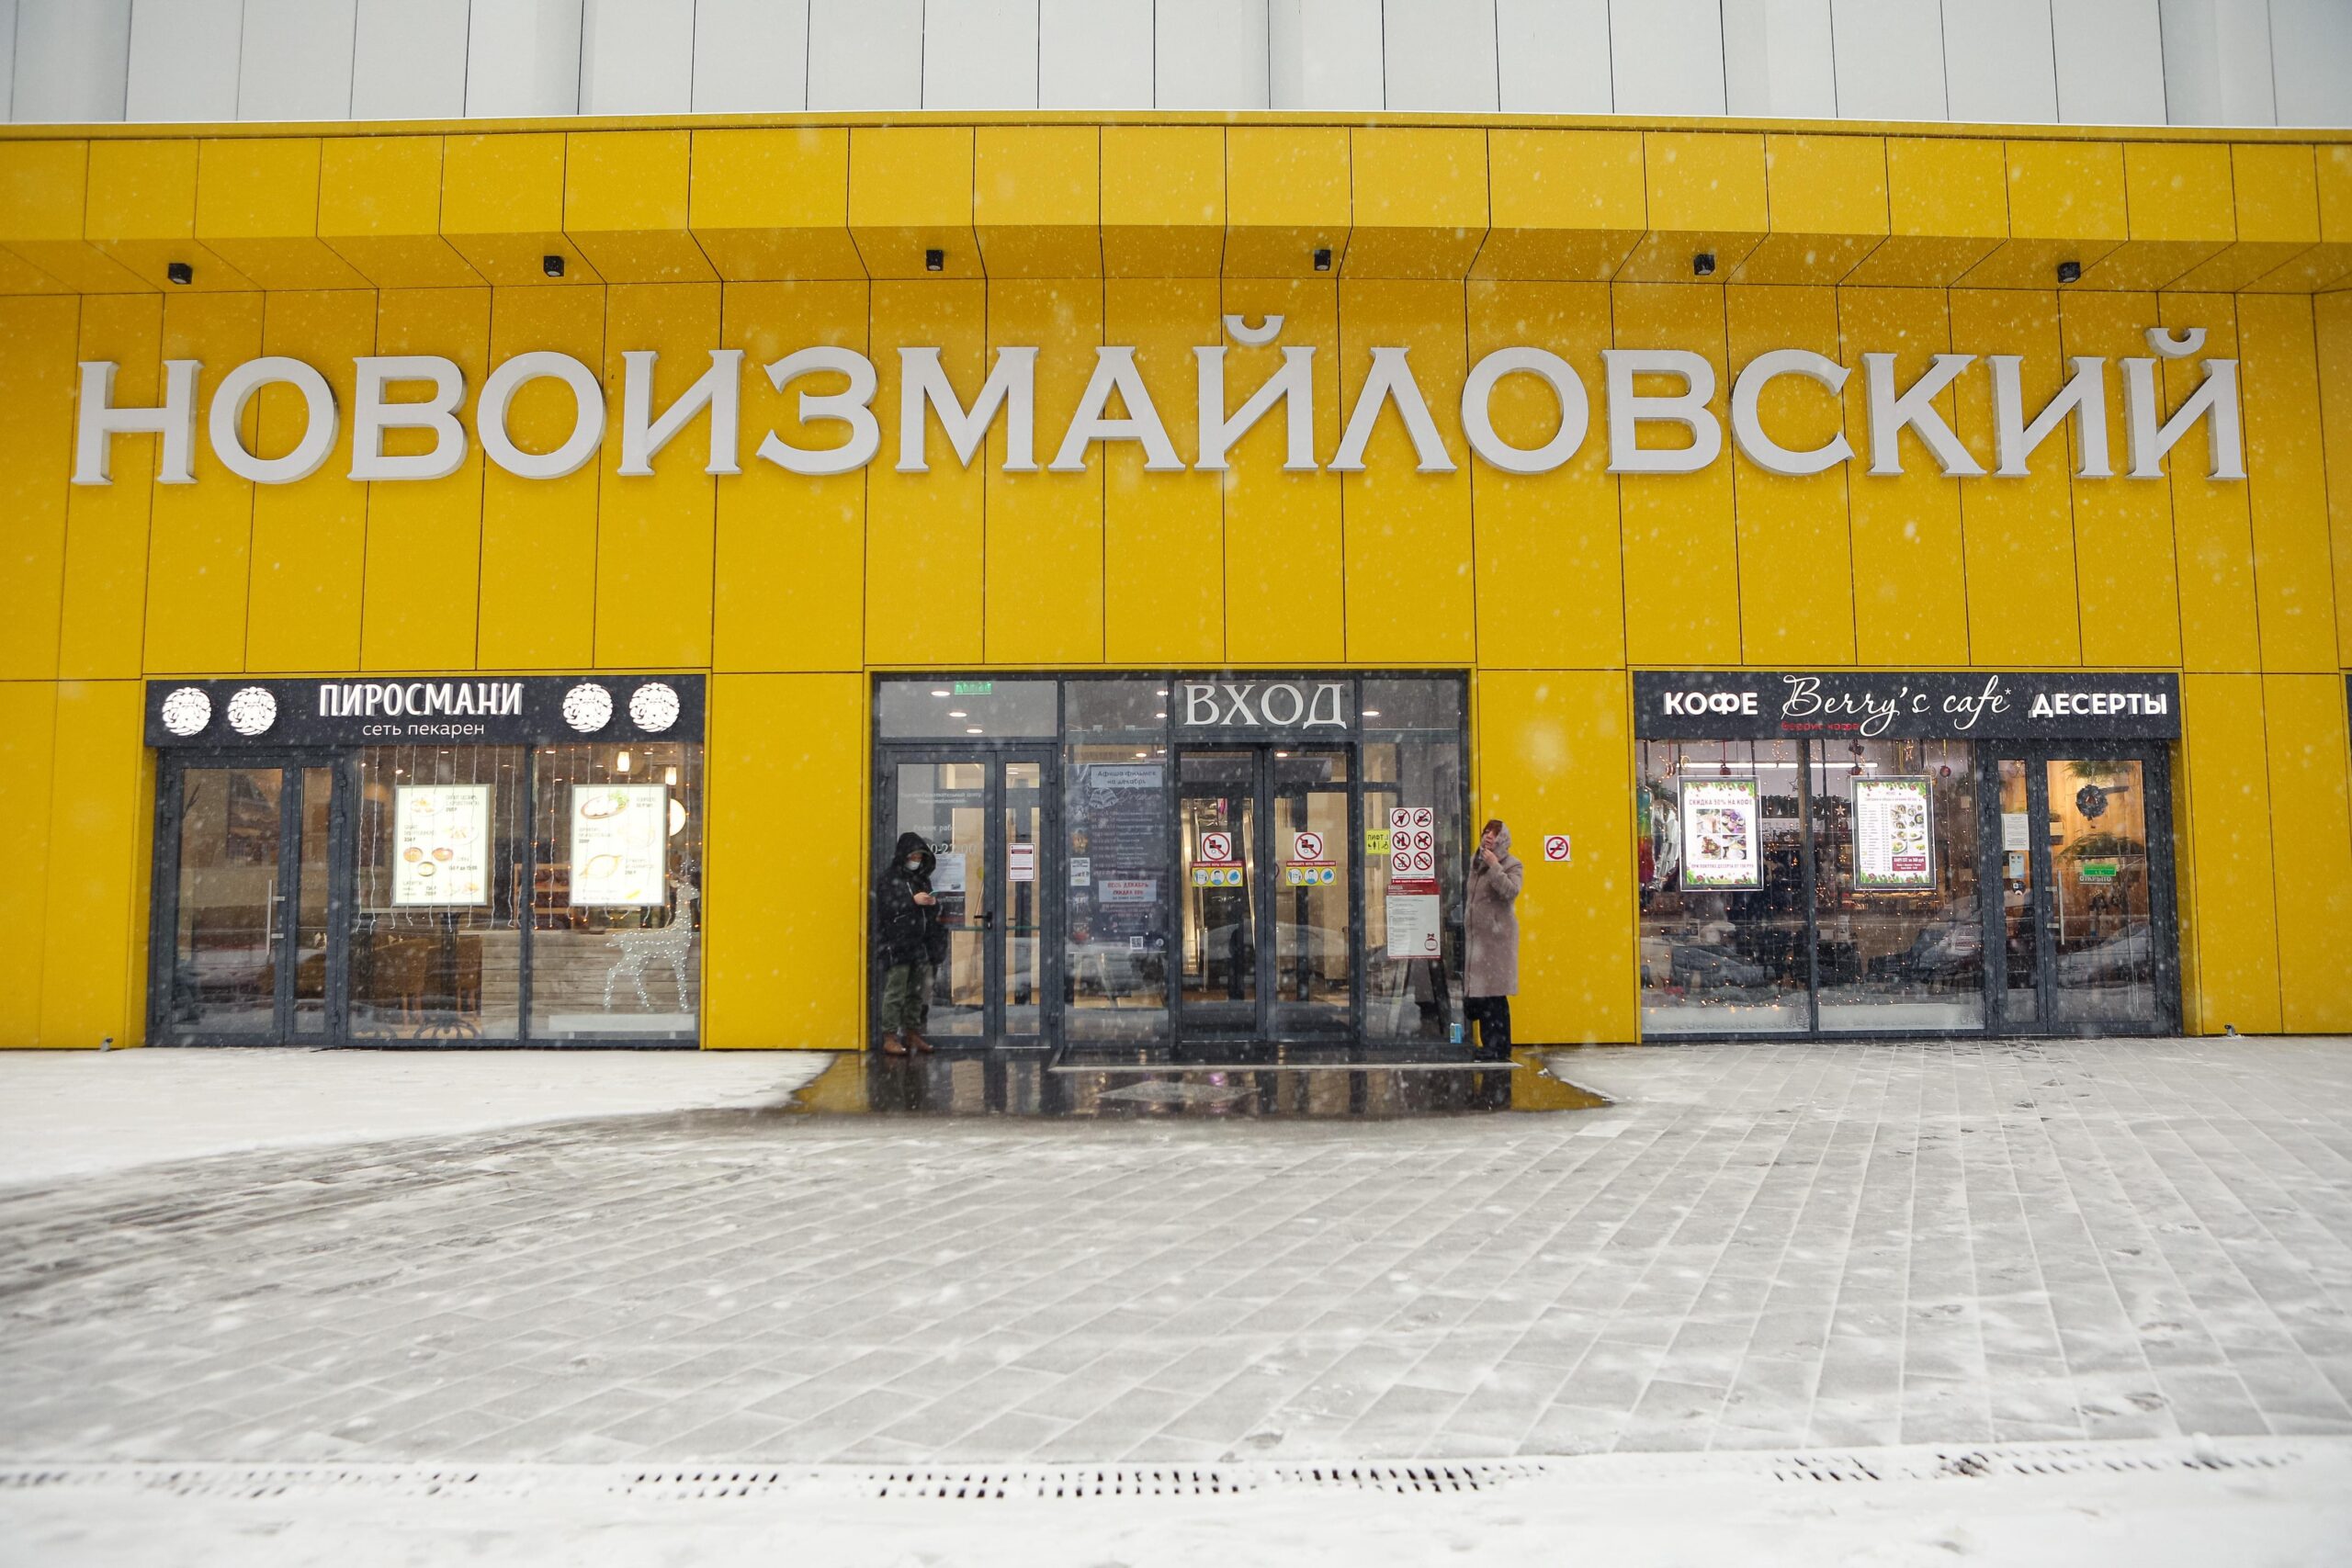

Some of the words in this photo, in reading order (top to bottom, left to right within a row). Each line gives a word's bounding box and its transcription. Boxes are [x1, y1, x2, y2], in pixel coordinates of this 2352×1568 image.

[72, 315, 2247, 486] НОВОИЗМАЙЛОВСКИЙ
[319, 682, 525, 717] ПИРОСМАНИ
[1183, 683, 1347, 730] ВХОД
[1664, 692, 1758, 716] КОФЕ
[1781, 675, 1930, 737] Berry's
[2029, 692, 2167, 718] ДЕСЕРТЫ
[362, 723, 401, 737] сеть
[407, 723, 485, 739] пекарен
